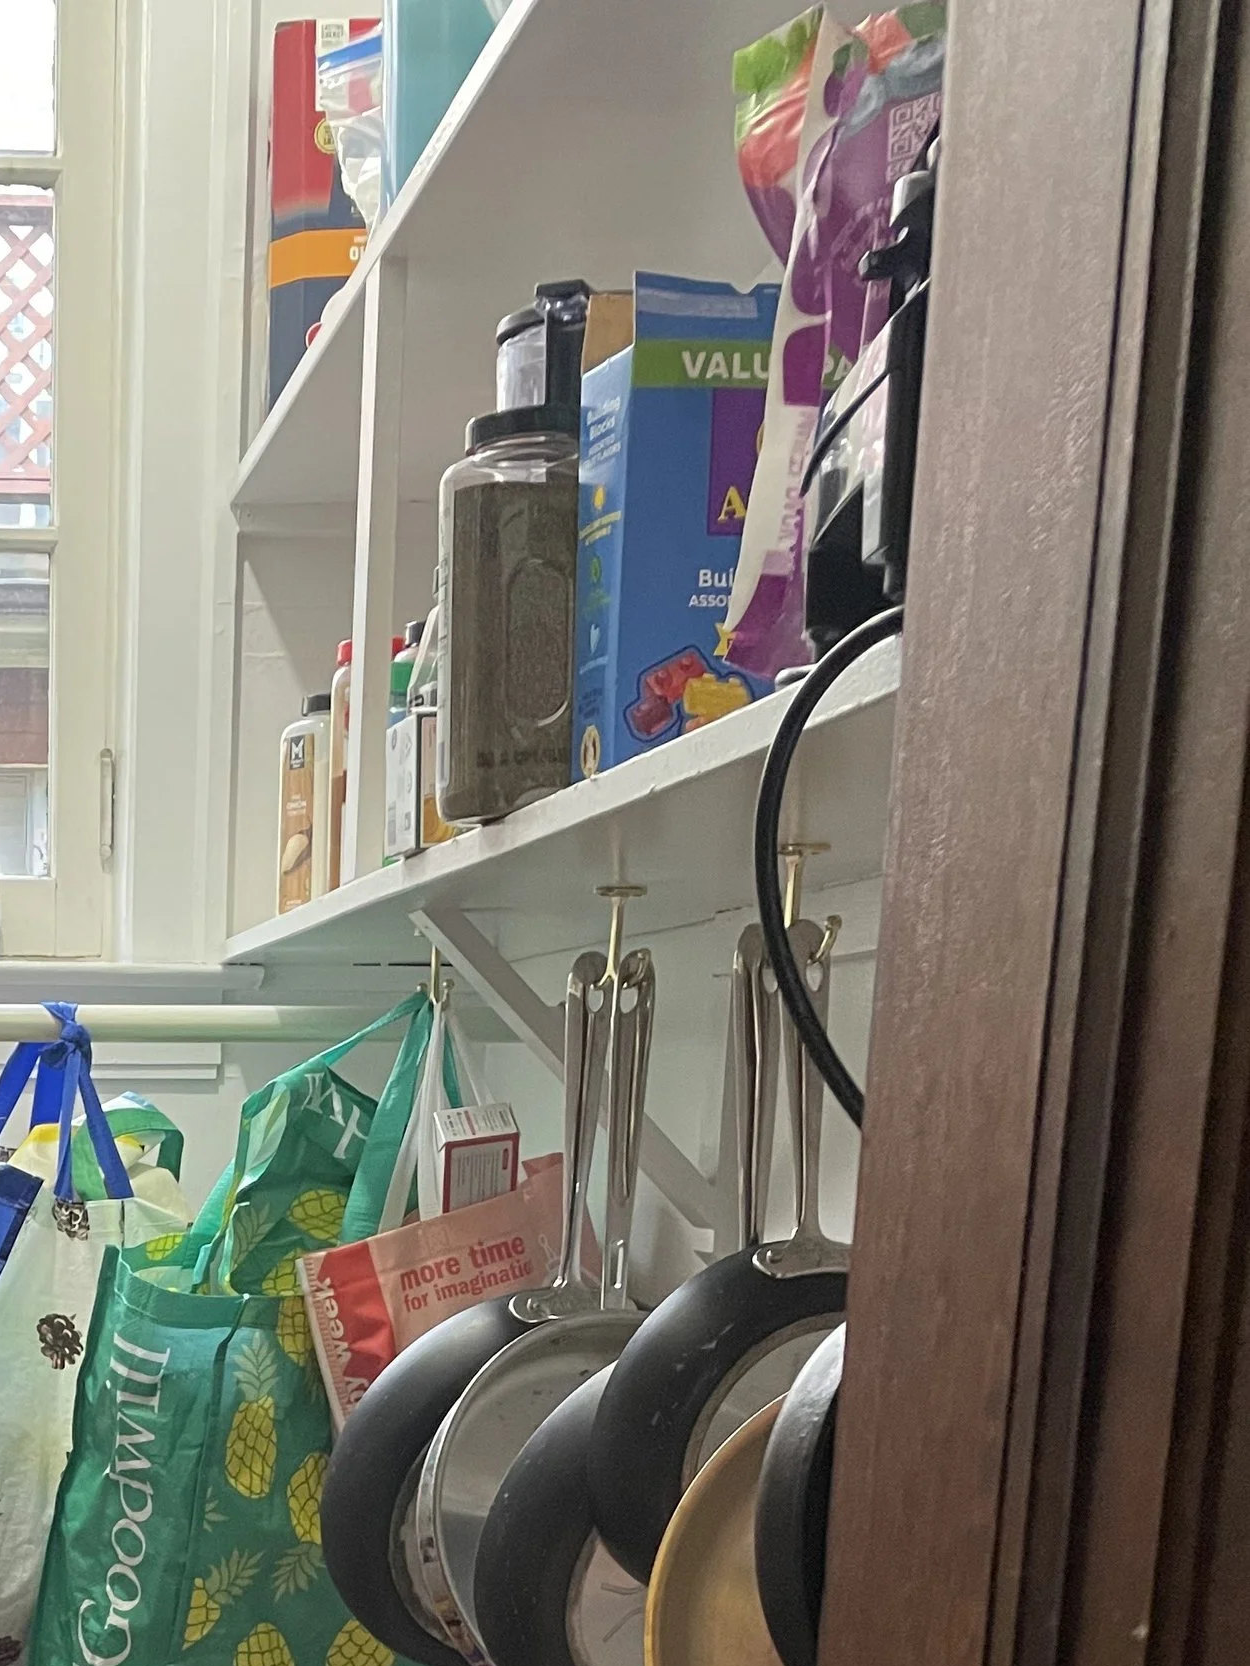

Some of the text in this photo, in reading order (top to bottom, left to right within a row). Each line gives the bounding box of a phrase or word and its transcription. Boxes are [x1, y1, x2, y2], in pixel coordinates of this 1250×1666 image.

[400, 1235, 527, 1292] more time
[315, 1276, 352, 1364] week
[404, 1292, 430, 1313] for
